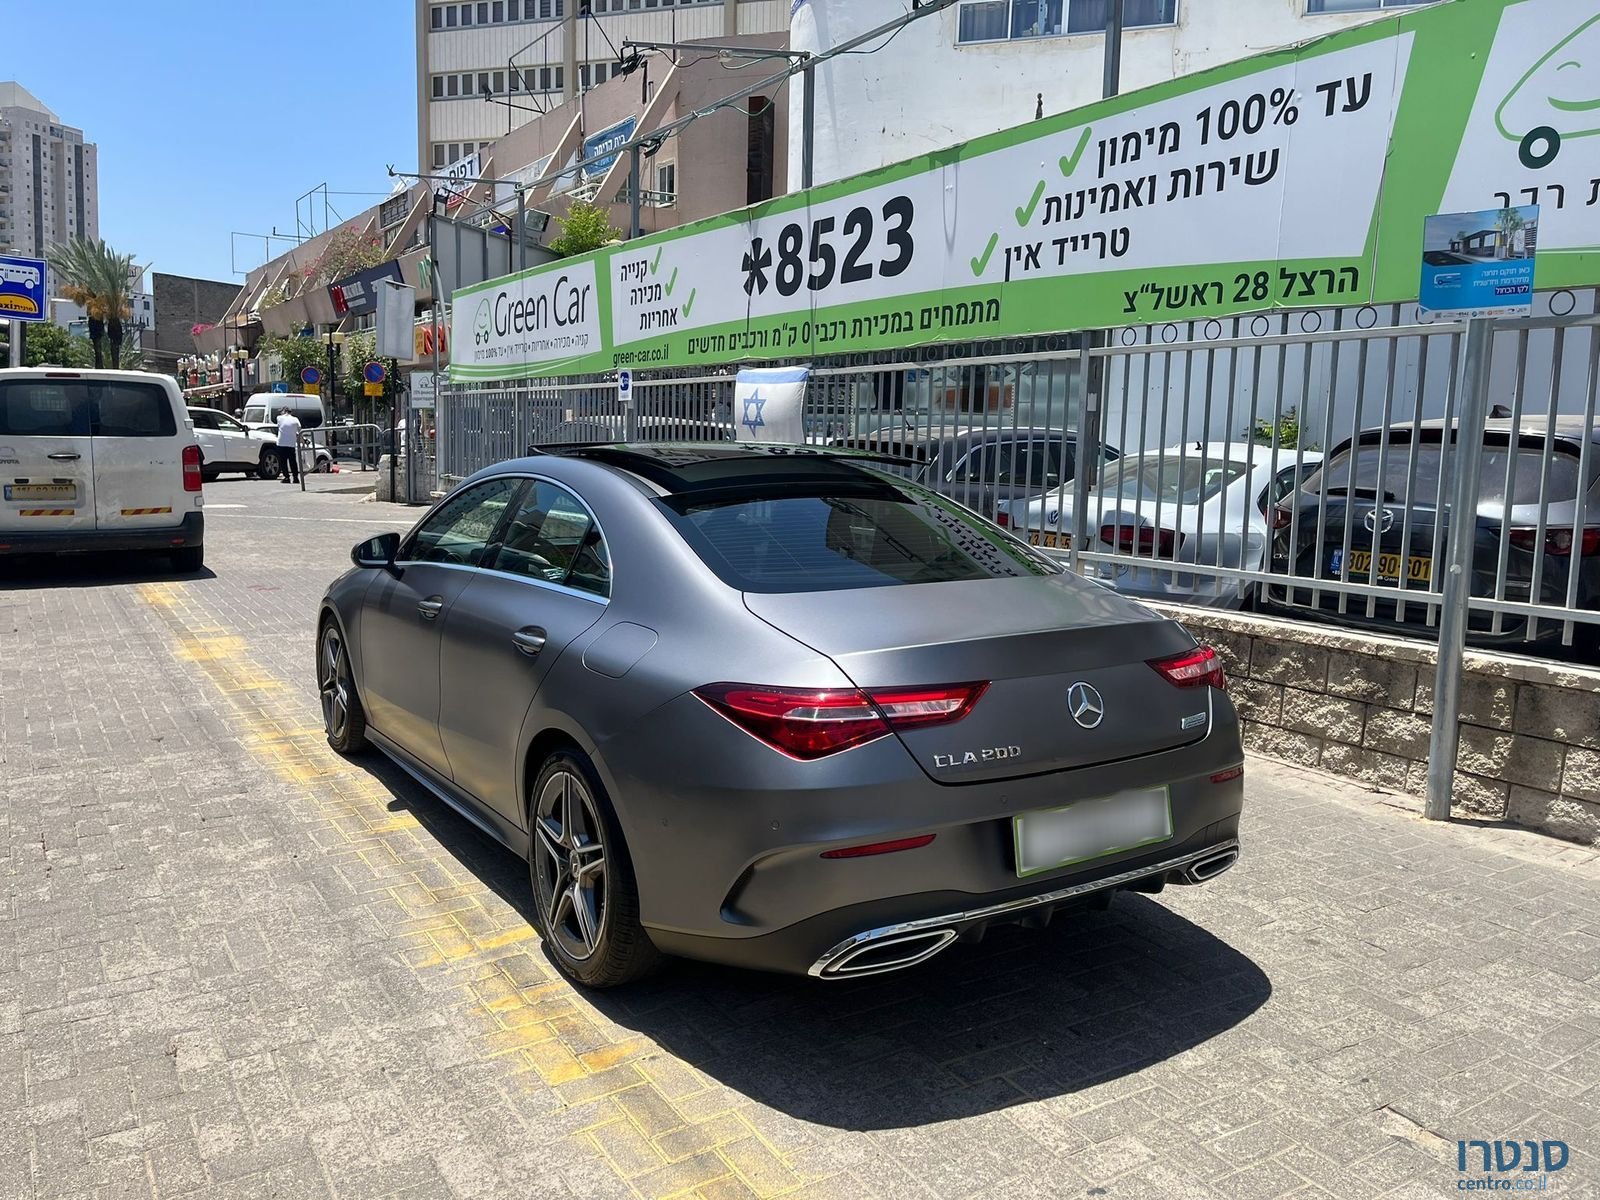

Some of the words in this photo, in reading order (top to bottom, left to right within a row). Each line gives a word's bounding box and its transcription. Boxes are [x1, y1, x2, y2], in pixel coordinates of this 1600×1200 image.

[1314, 72, 1372, 118] עד
[1196, 87, 1299, 146] 100%
[1097, 121, 1180, 179] מימון
[1166, 148, 1280, 202] שירות
[1042, 174, 1157, 226] ואמינות
[1004, 242, 1042, 282] אין
[1052, 226, 1130, 266] טרייד
[620, 259, 648, 283] קנייה
[1233, 271, 1270, 303] 28
[1279, 265, 1360, 300] הרצל
[494, 291, 548, 337] Green
[553, 275, 590, 327] Car
[630, 283, 662, 306] מכירה
[639, 307, 678, 331] אחריות
[850, 310, 914, 339] במכירת
[919, 298, 1000, 330] מתמחים
[687, 335, 725, 355] חדשים
[729, 329, 768, 350] ורכבים
[814, 321, 847, 343] רכבי
[613, 344, 669, 368] green-car.co.il
[933, 751, 978, 768] CLA
[981, 745, 1022, 762] 200
